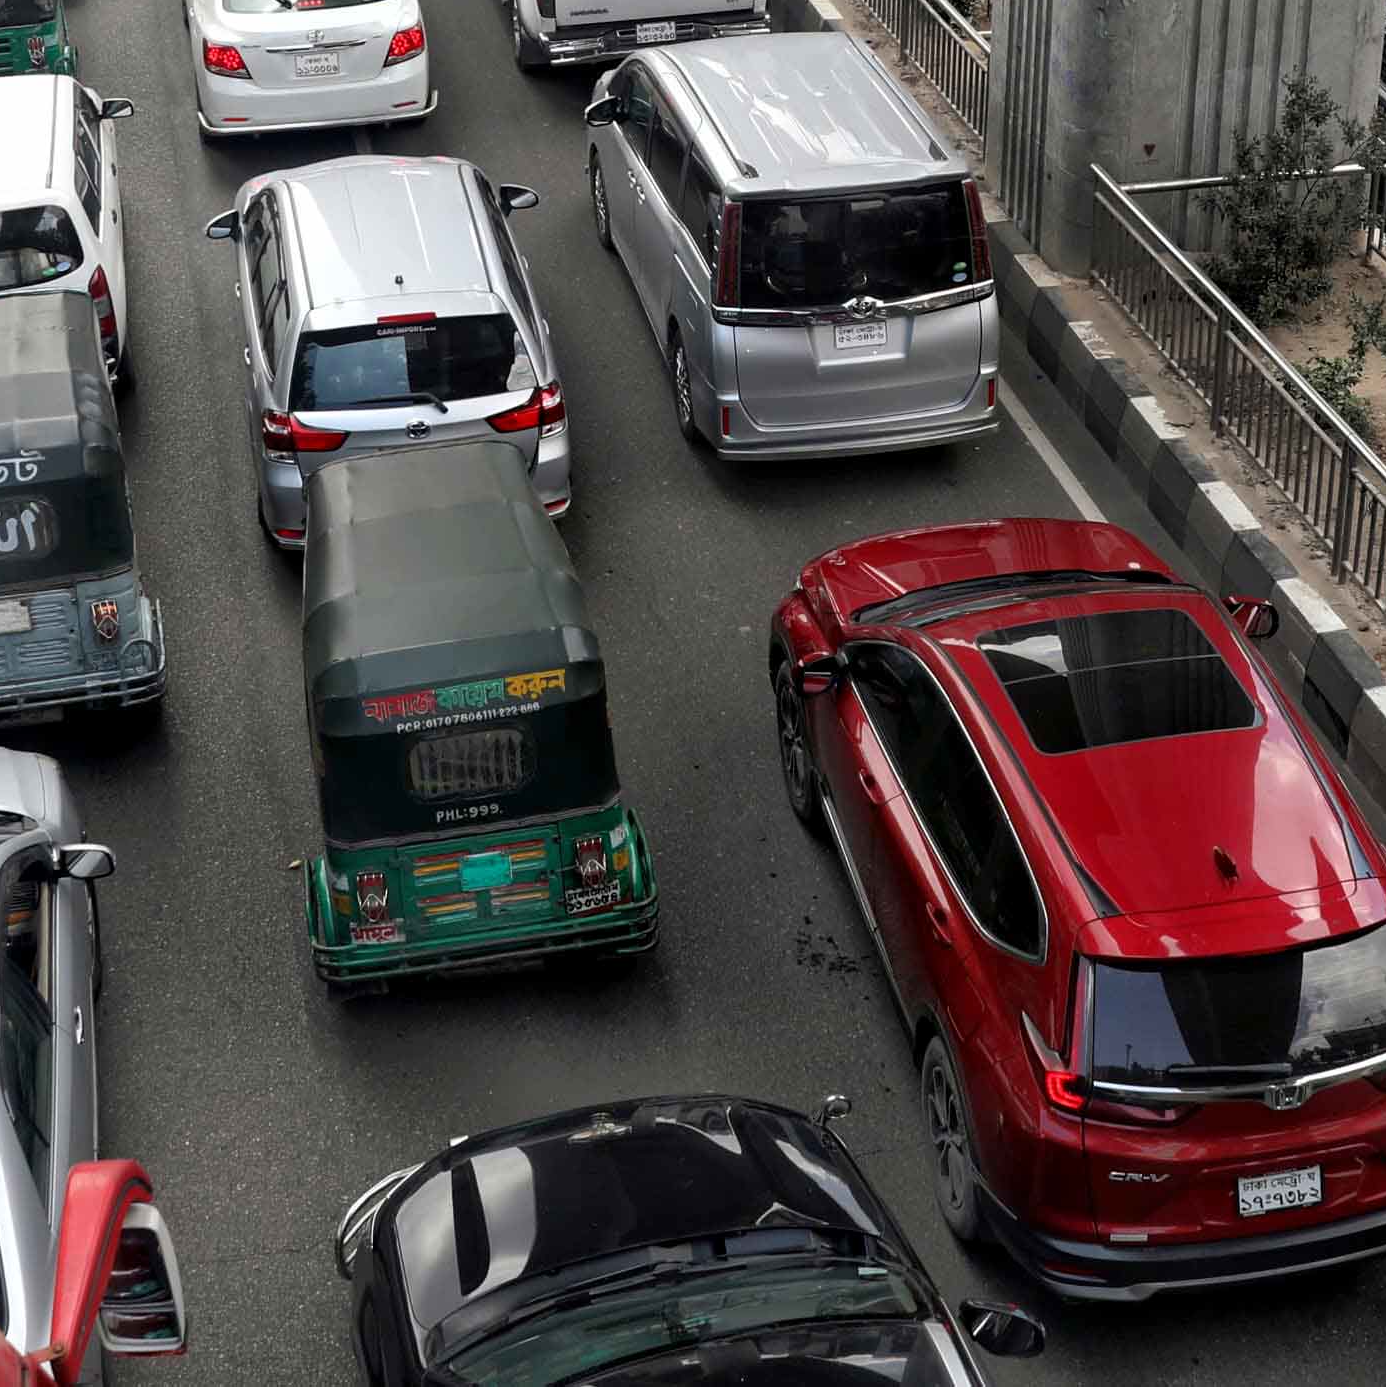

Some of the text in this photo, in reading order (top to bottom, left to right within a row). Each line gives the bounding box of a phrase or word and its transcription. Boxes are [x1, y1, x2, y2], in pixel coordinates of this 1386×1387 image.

[436, 677, 504, 710] কায়েম
[504, 668, 565, 700] করুন
[1109, 1170, 1172, 1183] CR-V
